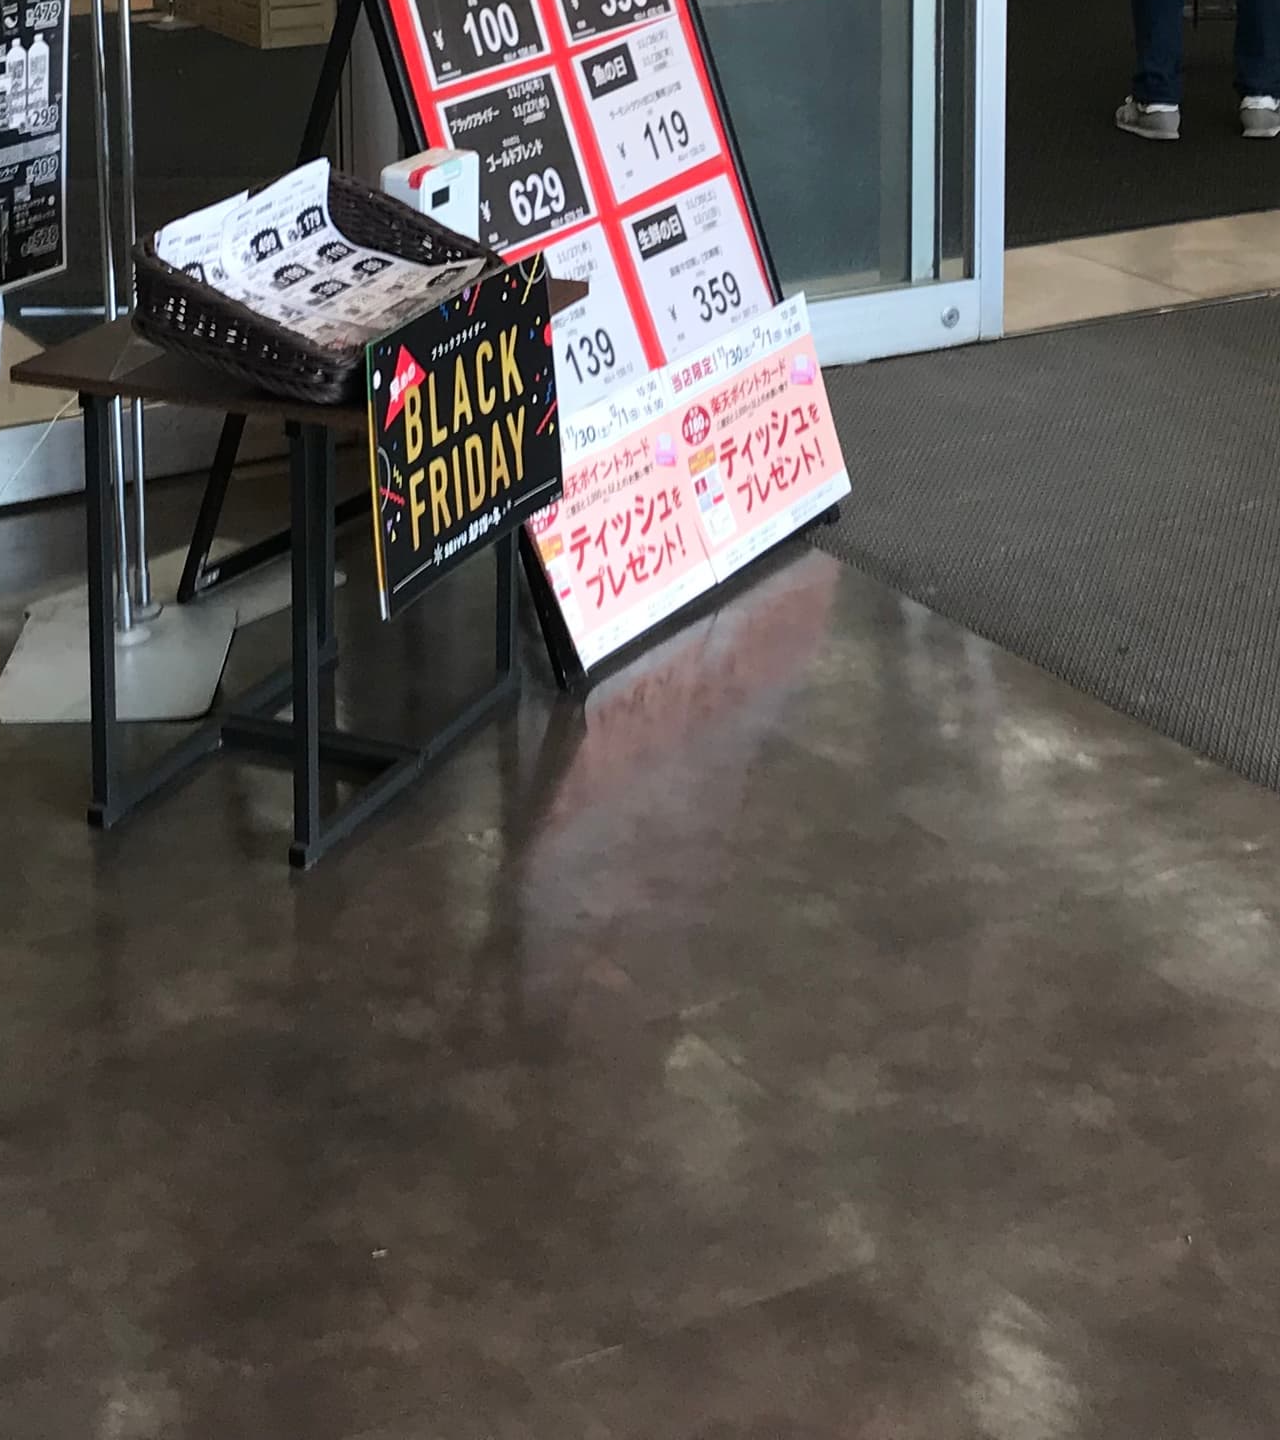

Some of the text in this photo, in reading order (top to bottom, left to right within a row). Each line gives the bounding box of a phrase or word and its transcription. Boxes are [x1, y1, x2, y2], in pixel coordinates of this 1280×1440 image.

[33, 0, 62, 21] 479
[432, 28, 444, 51] ¥
[463, 2, 520, 57] 100
[591, 54, 629, 89] 魚の日
[31, 105, 59, 128] 298
[616, 109, 690, 161] ¥ 119
[30, 155, 59, 177] 409
[485, 138, 544, 174] ゴールドブレンド
[479, 166, 566, 227] ¥ 629
[636, 213, 684, 253] 生鮮の日
[666, 270, 742, 323] ¥ 359
[430, 321, 488, 362] ブラックフライデー
[565, 327, 616, 385] 139
[403, 323, 524, 465] BLACK
[719, 402, 822, 479] ティッシュを
[407, 404, 526, 552] FRIDAY
[736, 436, 826, 513] プレゼント!
[443, 530, 468, 560] SEIYU
[568, 484, 684, 571] ティッシュを
[585, 524, 687, 609] プレゼント!
